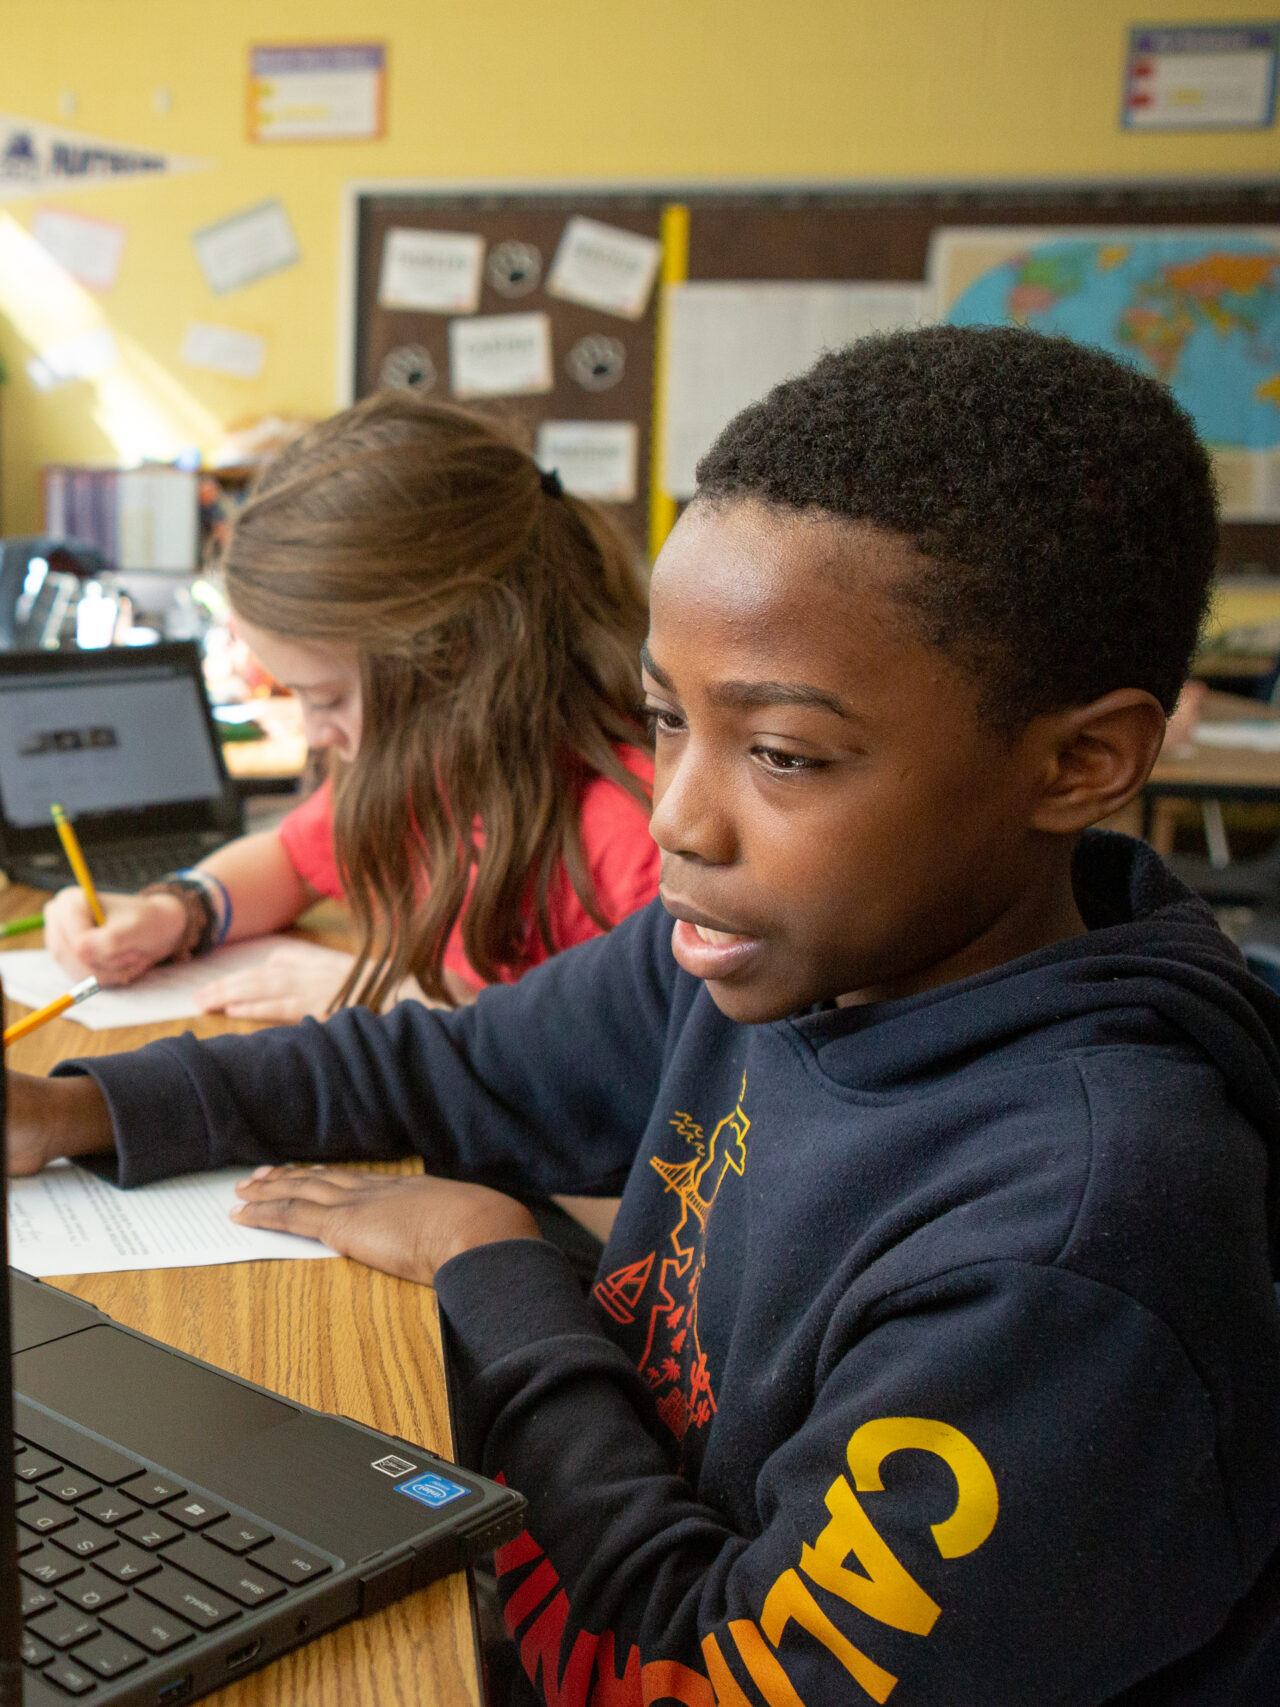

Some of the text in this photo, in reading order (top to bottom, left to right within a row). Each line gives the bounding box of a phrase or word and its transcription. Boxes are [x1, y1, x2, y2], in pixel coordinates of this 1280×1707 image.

[21, 1467, 38, 1476] V
[61, 1487, 78, 1496] C
[99, 1508, 120, 1520] X
[36, 1517, 55, 1528] D
[141, 1532, 161, 1544] Z
[77, 1540, 95, 1551] S
[34, 1564, 57, 1579] W
[120, 1563, 138, 1575] A
[239, 1578, 266, 1595] Shift
[81, 1591, 101, 1604] Q
